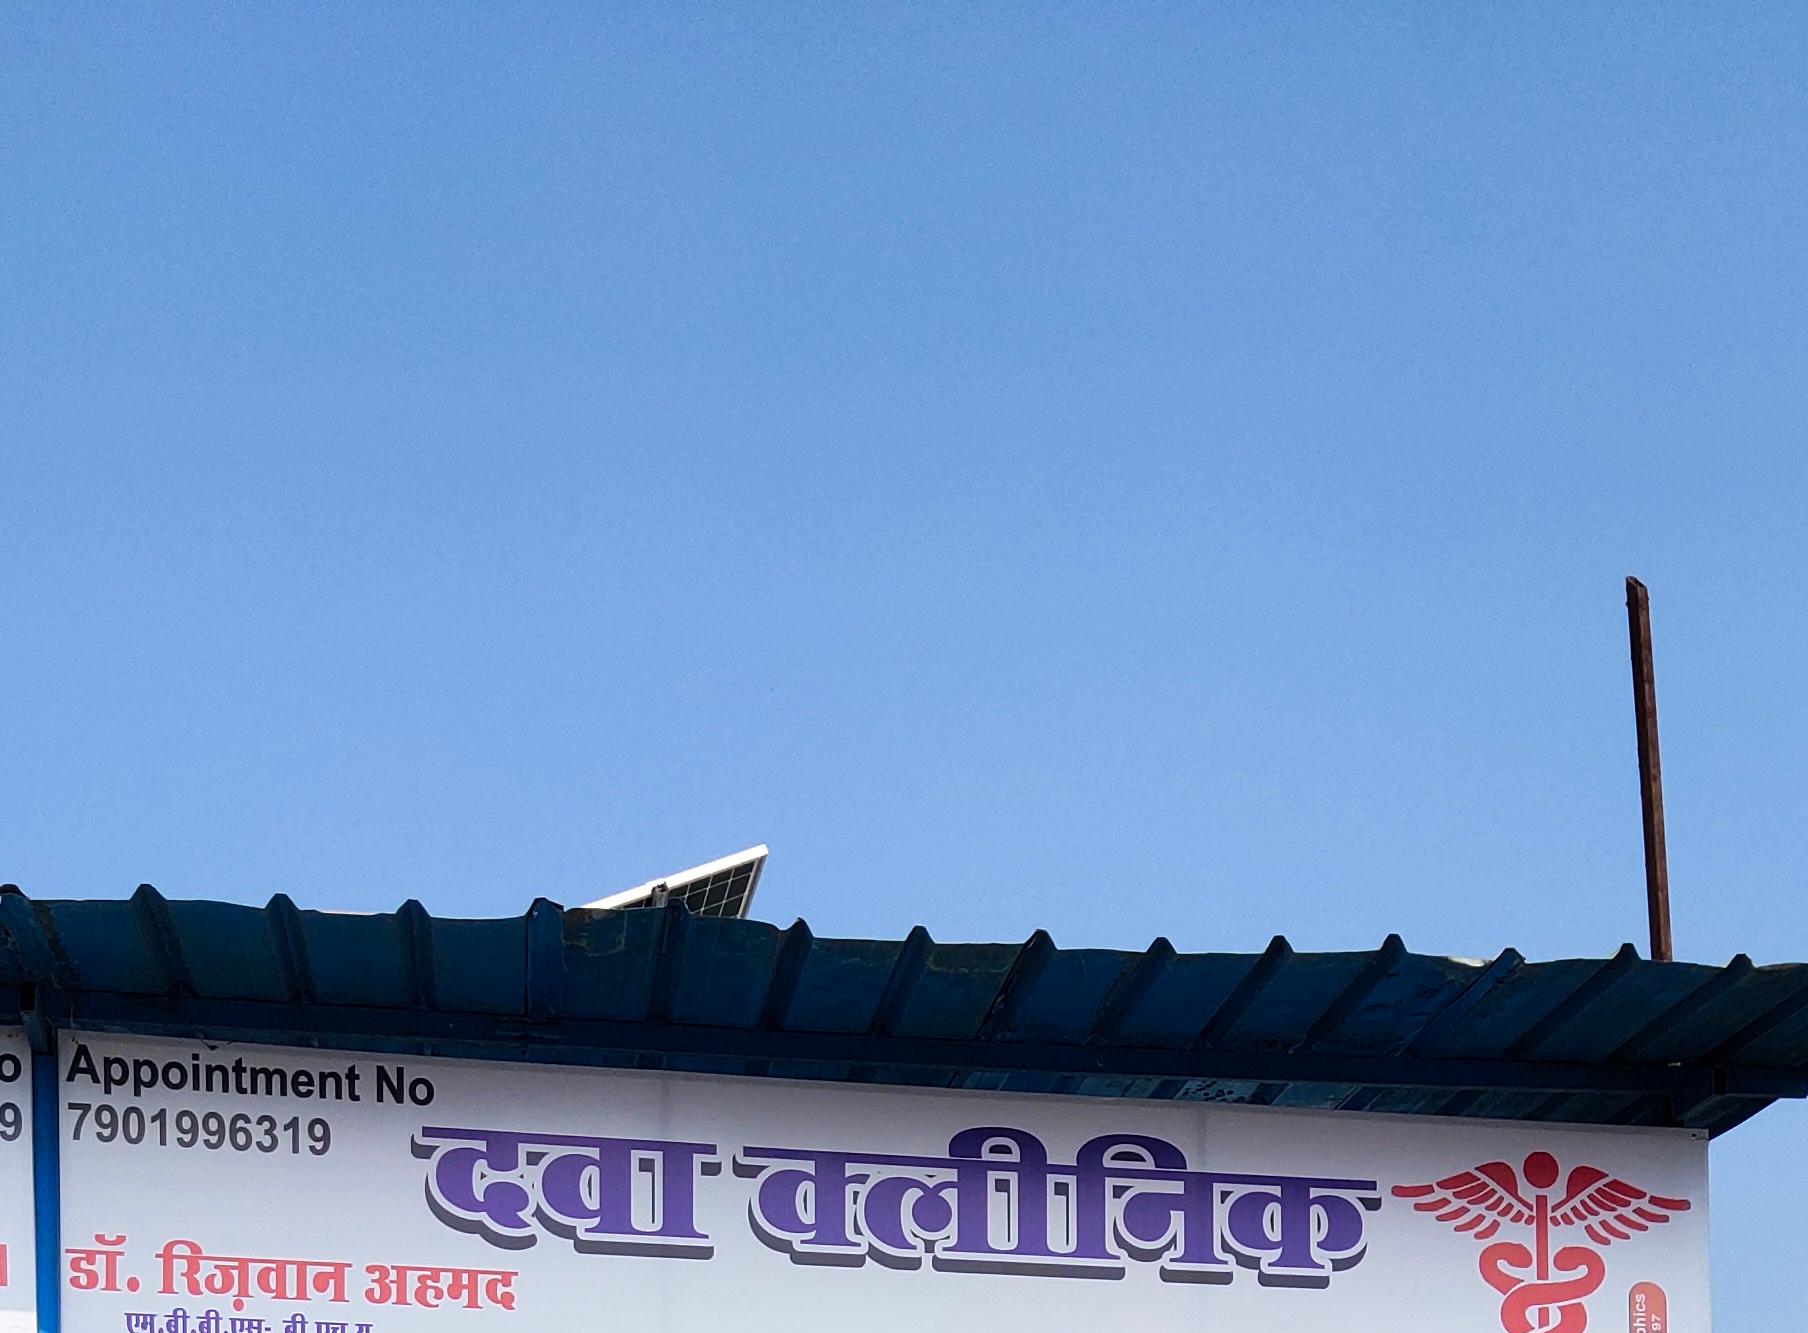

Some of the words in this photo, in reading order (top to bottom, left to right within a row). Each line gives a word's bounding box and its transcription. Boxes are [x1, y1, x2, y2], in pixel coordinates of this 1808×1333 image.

[65, 1044, 361, 1102] Appointment
[376, 1065, 435, 1105] No
[67, 1102, 332, 1156] 7901996319
[410, 1125, 723, 1260] दवा
[732, 1126, 1382, 1289] क्लीनिक
[64, 1233, 141, 1292] डॉ.
[154, 1239, 353, 1312] रिज़वान
[364, 1262, 519, 1311] अहमद
